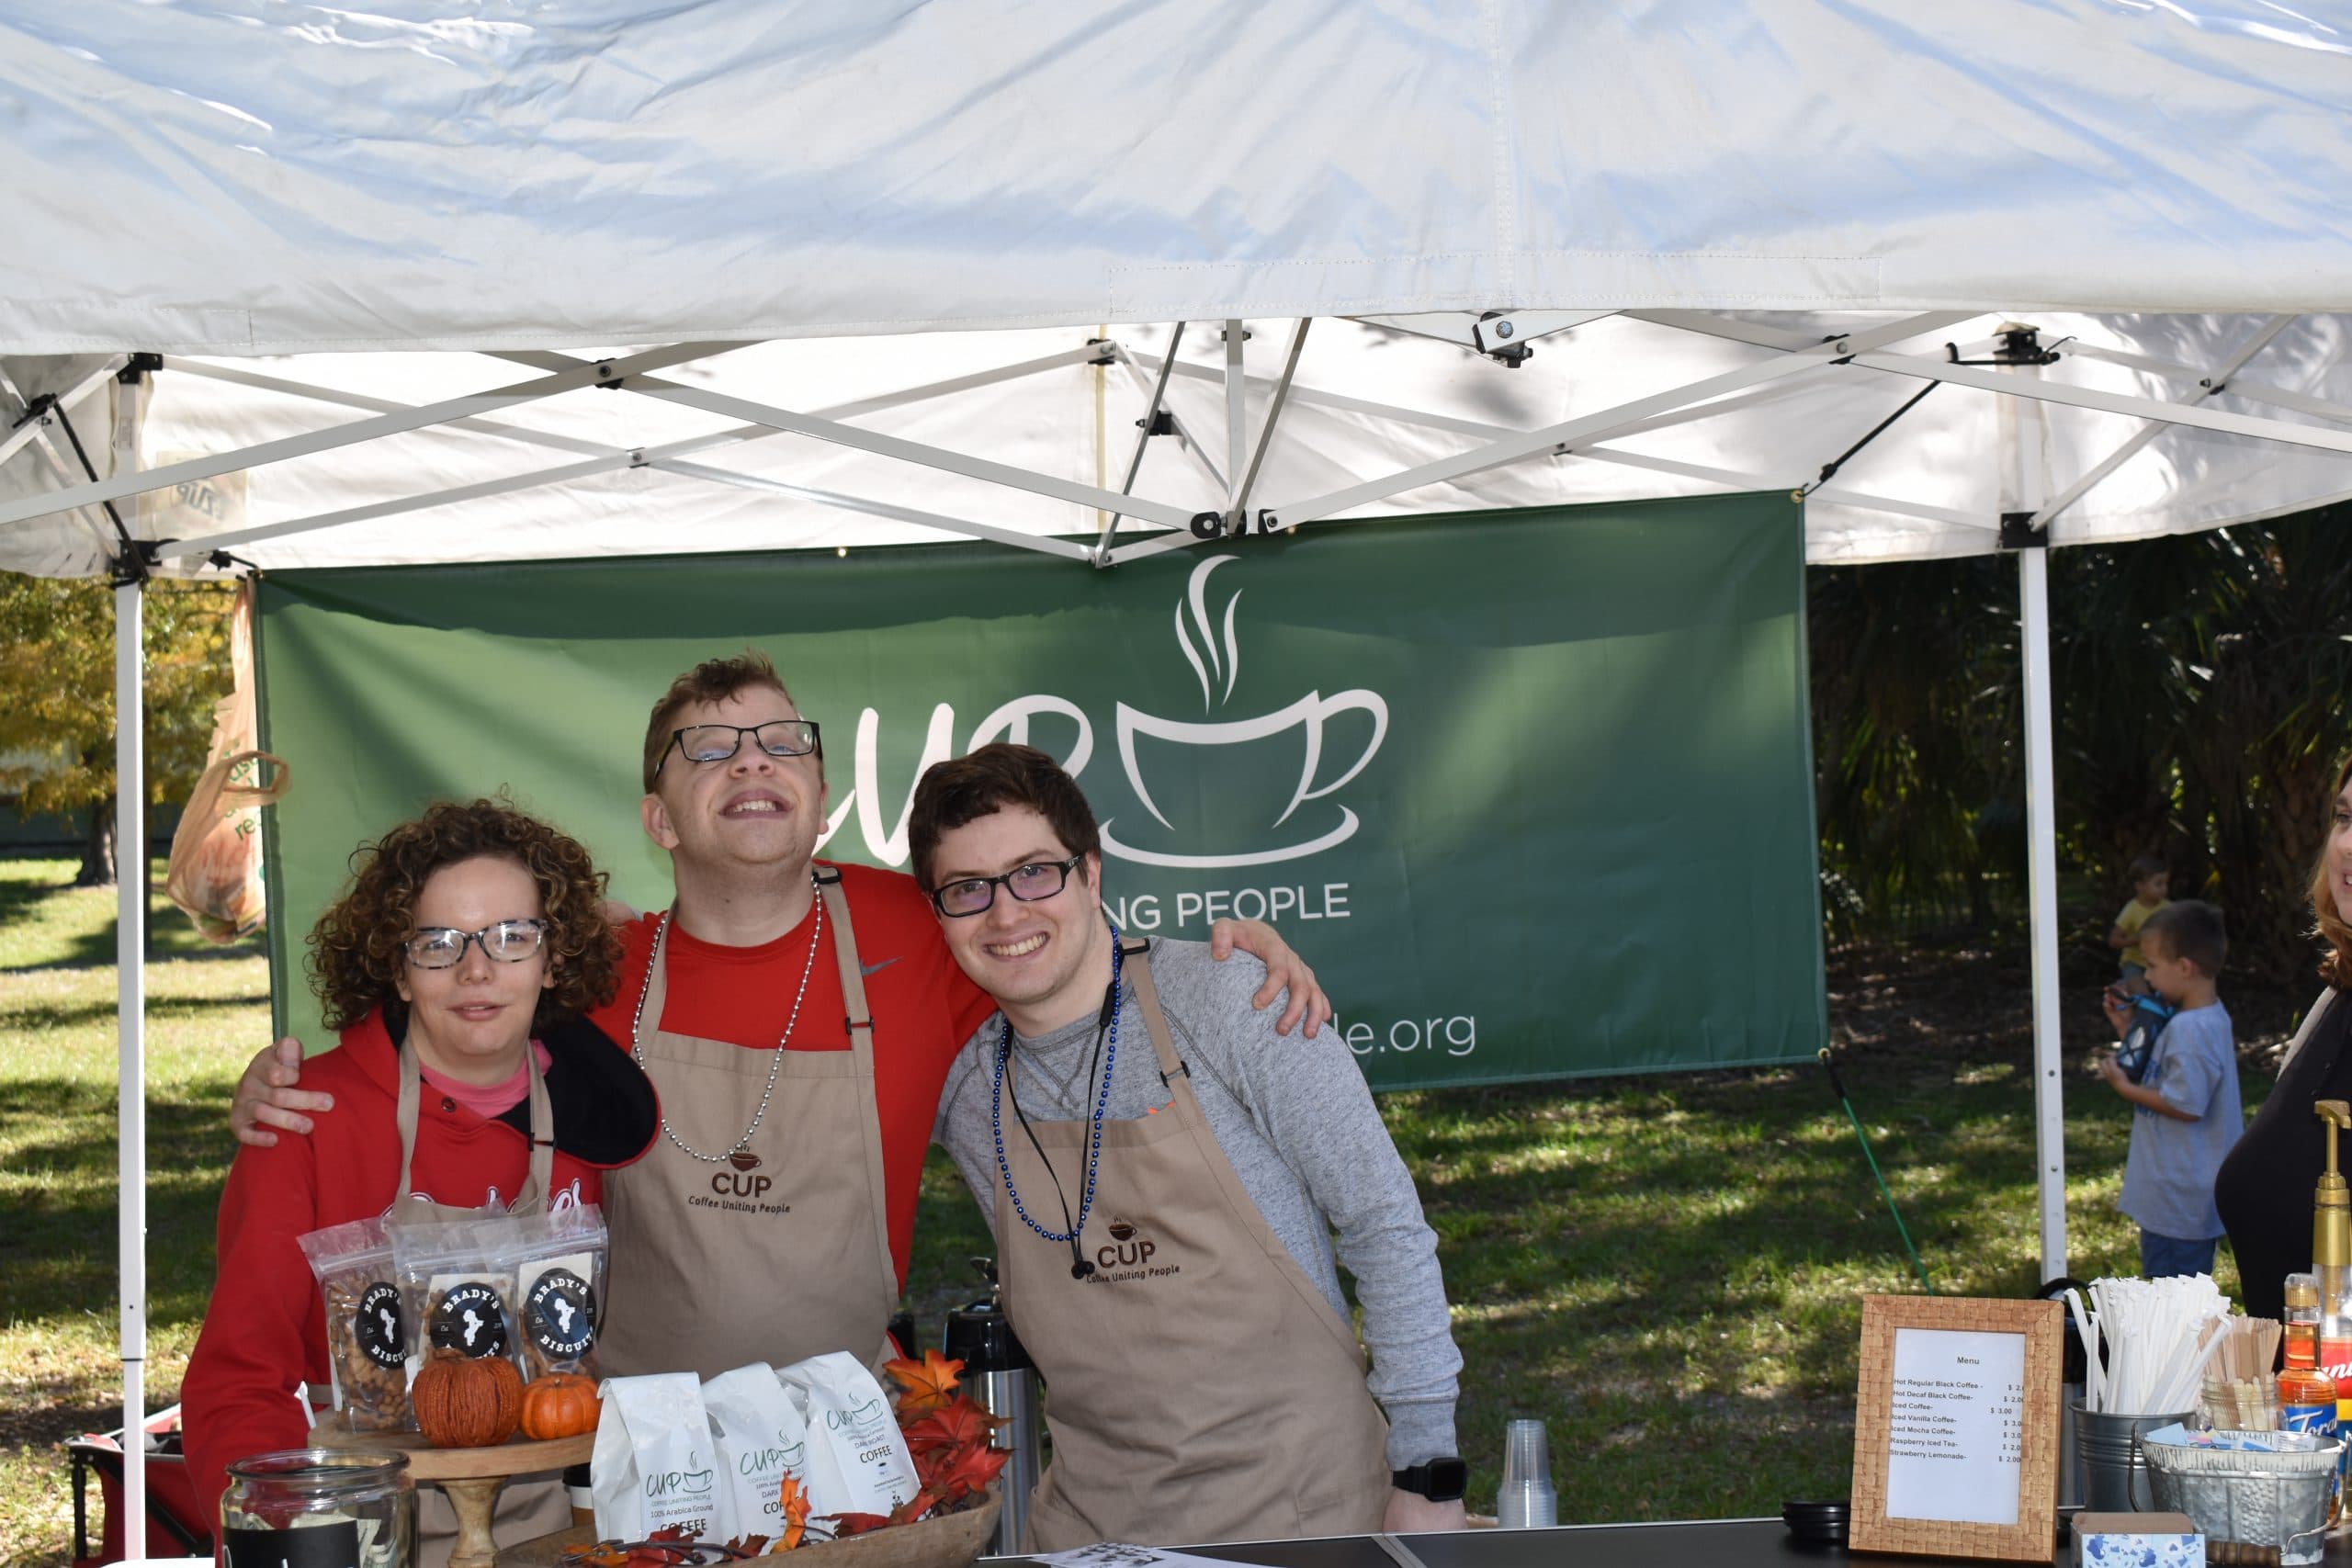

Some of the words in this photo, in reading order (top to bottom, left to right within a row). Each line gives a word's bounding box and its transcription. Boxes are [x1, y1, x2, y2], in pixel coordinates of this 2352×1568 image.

[811, 694, 1094, 867] UP
[1177, 883, 1351, 928] PEOPLE
[1335, 1013, 1477, 1056] e.org
[711, 1172, 772, 1198] CUP
[689, 1196, 718, 1207] Coffee
[722, 1200, 756, 1213] Uniting
[760, 1203, 790, 1214] People
[1097, 1241, 1156, 1269] CUP
[1112, 1268, 1145, 1282] Uniting
[1148, 1264, 1180, 1277] People
[443, 1290, 500, 1314] BRADY'S
[534, 1279, 587, 1304] BRADY'S
[1957, 1357, 1980, 1365] Menu
[827, 1410, 853, 1430] CUP
[2290, 1409, 2337, 1437] Tora
[860, 1445, 892, 1463] COFFEE
[1889, 1450, 1927, 1458] Strawberry
[1891, 1438, 1925, 1446] Raspberry
[740, 1448, 779, 1475] CUP
[646, 1472, 682, 1497] CUP
[762, 1490, 779, 1498] DARK
[650, 1510, 665, 1518] 100%
[666, 1506, 691, 1516] Arabica
[693, 1504, 713, 1512] Ground
